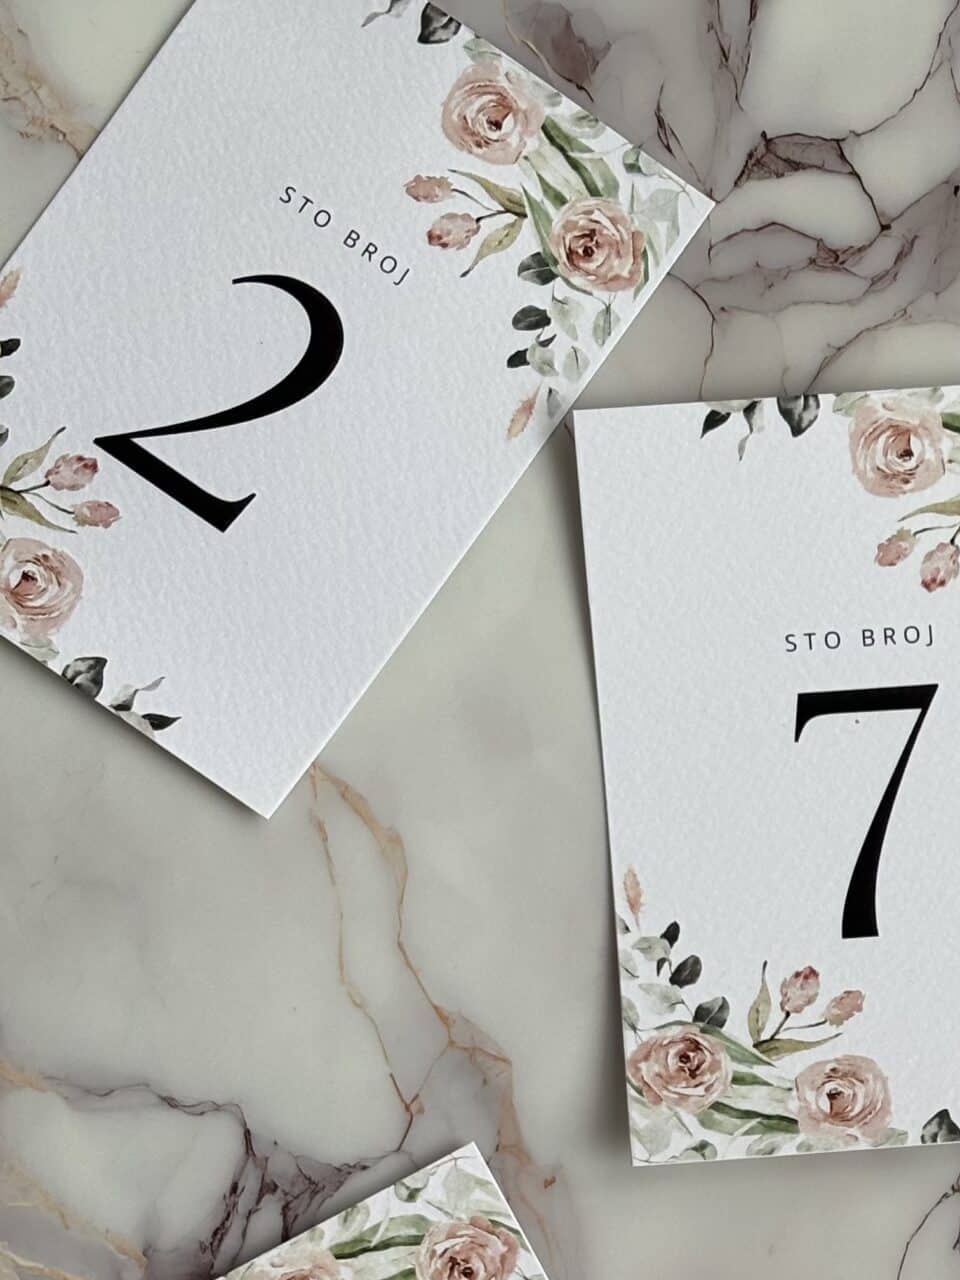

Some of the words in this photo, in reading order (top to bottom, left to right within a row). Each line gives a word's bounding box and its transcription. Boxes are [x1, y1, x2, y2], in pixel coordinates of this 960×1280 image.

[279, 186, 332, 228] STO
[342, 229, 411, 287] BROJ
[93, 274, 344, 533] 2
[784, 630, 841, 653] STO
[861, 624, 934, 648] BROJ
[795, 683, 939, 939] 7
